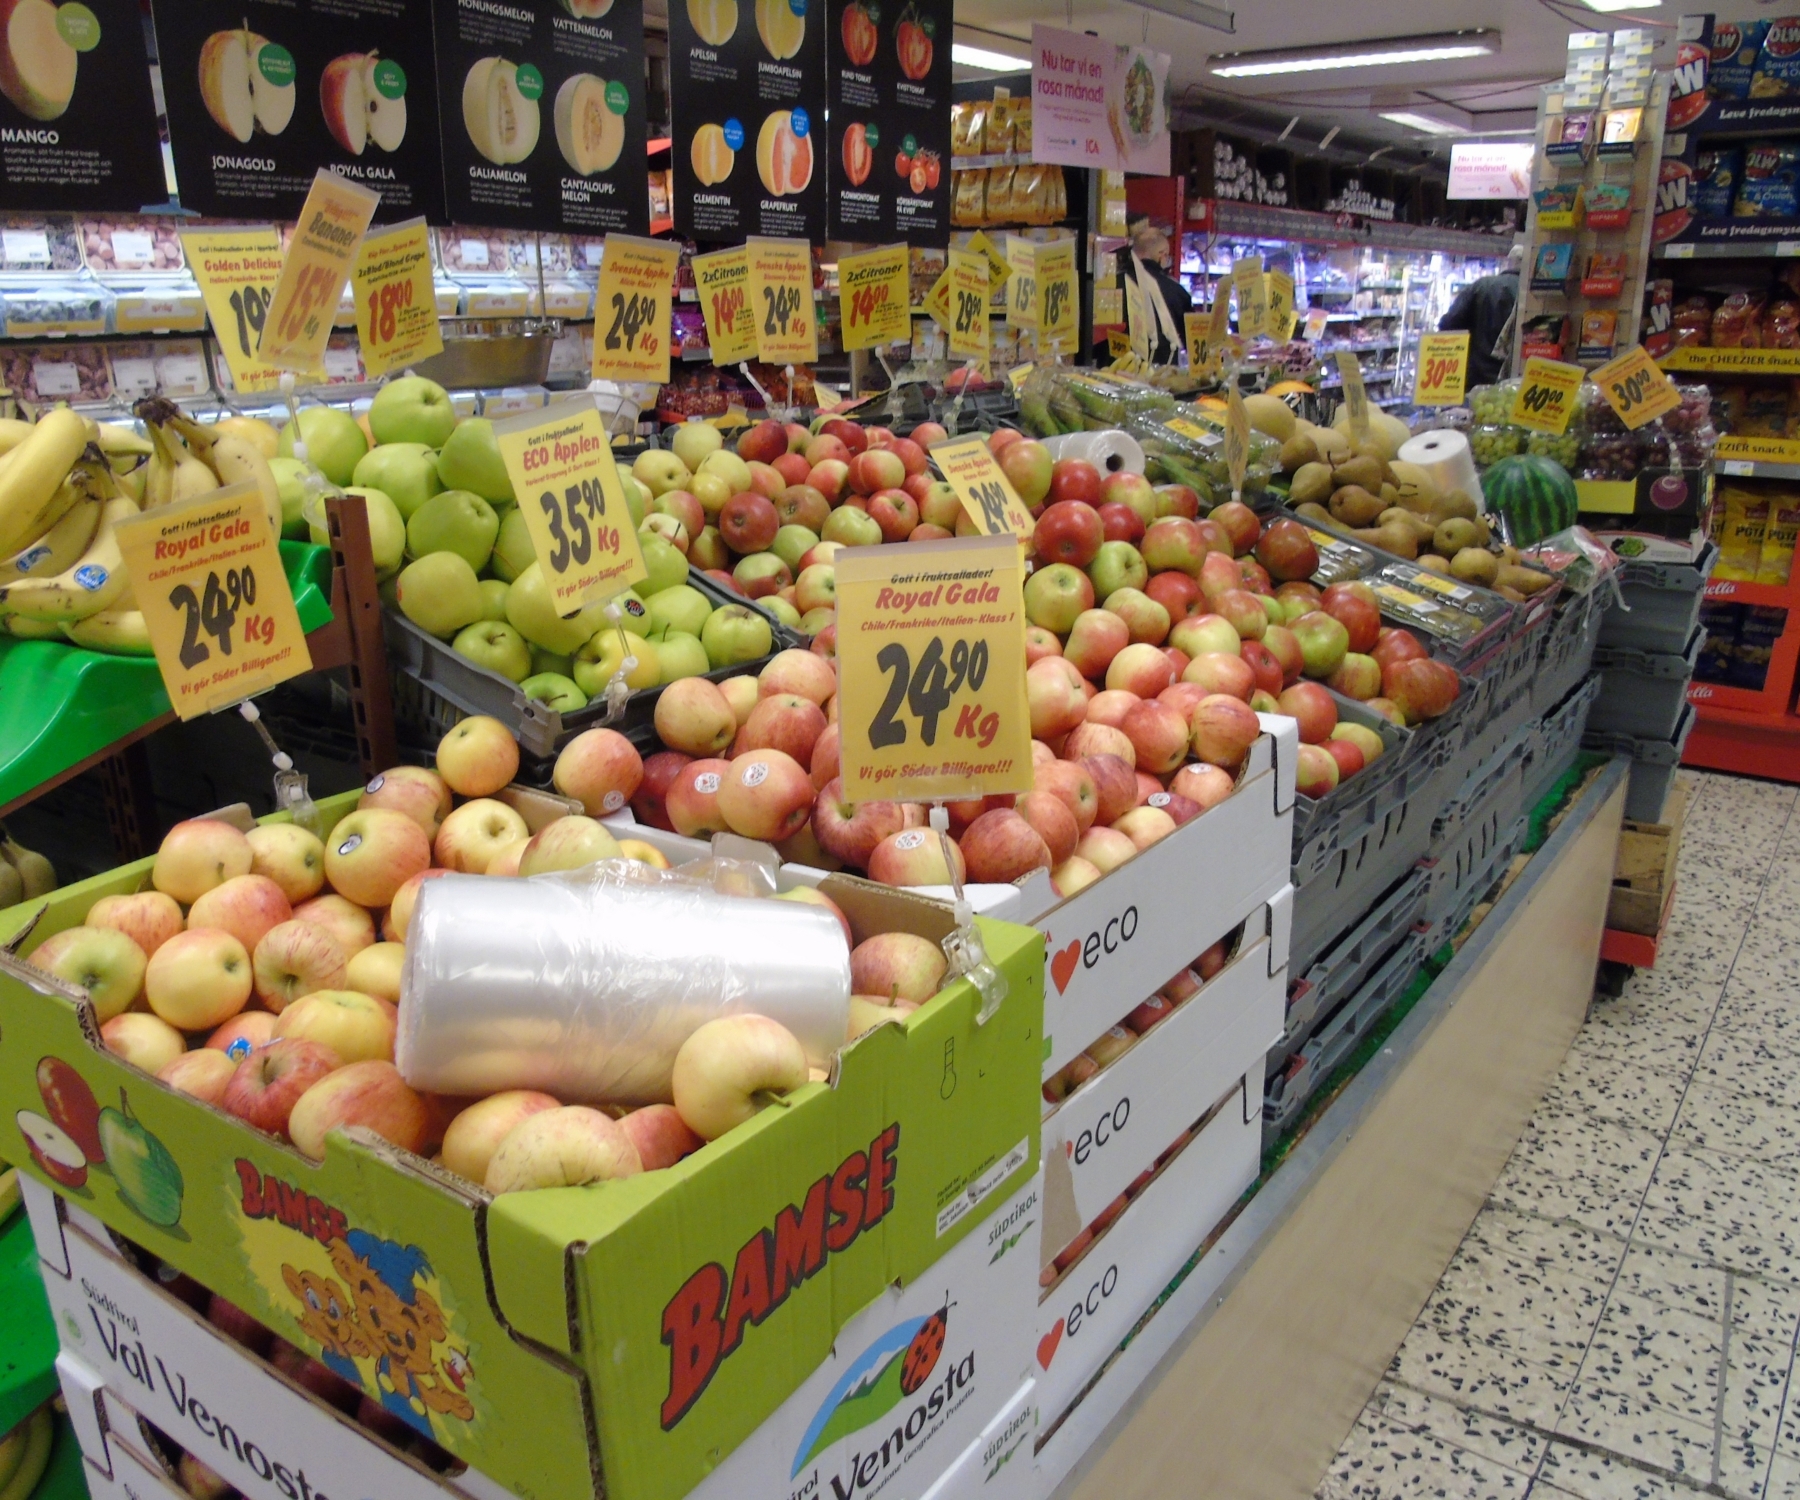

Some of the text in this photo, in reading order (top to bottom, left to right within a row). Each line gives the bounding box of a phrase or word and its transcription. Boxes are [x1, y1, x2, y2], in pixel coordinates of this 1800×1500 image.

[553, 18, 612, 40] VATTENMELON
[690, 49, 717, 62] APELSIN
[1042, 49, 1102, 79] Nu tar vi en
[759, 62, 802, 79] JUMBOAPELSIN
[1037, 79, 1104, 104] rosa månad!
[1, 128, 59, 144] MANGO
[1085, 138, 1099, 155] ICA
[212, 156, 276, 172] JONAGOLD
[330, 164, 395, 180] ROYAL GALA
[469, 166, 527, 183] GALIAMELON
[562, 190, 590, 202] MELON
[694, 195, 731, 206] CLEMENTIN
[760, 200, 798, 212] GRAPEFRUKT
[309, 211, 357, 247] Bananer
[204, 260, 240, 272] Golden
[609, 261, 669, 280] Svenska Äpplen
[756, 259, 806, 272] Svenska Äpplen
[846, 264, 903, 283] 2xCitroner
[763, 284, 800, 337] 2490
[850, 283, 889, 328] 1400
[605, 292, 656, 352] 2490
[792, 318, 806, 338] Kg
[640, 332, 658, 356] Kg
[1689, 354, 1800, 366] the CHEEZIER snack
[528, 435, 541, 446] Gott
[546, 423, 584, 440] fruktsallader!
[523, 436, 600, 471] ECO Äpplen
[1752, 445, 1784, 454] snack
[161, 525, 179, 536] Gott
[186, 506, 241, 530] fruktsallader!
[539, 476, 606, 574] 3590
[1008, 510, 1025, 529] Kg
[154, 518, 250, 560] Royal Gala
[597, 524, 620, 556] Kg
[891, 573, 913, 584] Gott
[921, 569, 994, 582] fruktsallader!
[557, 584, 564, 598] Vi
[565, 581, 577, 598] gör
[875, 581, 1001, 614] Royal Gala
[169, 564, 256, 670] 2490
[1009, 612, 1015, 622] 1
[244, 614, 276, 646] Kg
[181, 646, 292, 695] Vi gör Söder Billigare!!!
[868, 636, 989, 750] 2490
[953, 704, 1000, 749] Kg
[859, 759, 1013, 783] Vi gör Söder Billigare!!!
[1083, 905, 1138, 969] eco
[1075, 1097, 1130, 1165] eco
[234, 1157, 348, 1246] BAMSE
[660, 1121, 900, 1433] BAMSE
[81, 1277, 140, 1336] Südtirol
[1067, 1264, 1117, 1337] eco
[88, 1303, 155, 1392] Val
[830, 1350, 976, 1500] Venosta
[903, 1419, 944, 1463] Geografica
